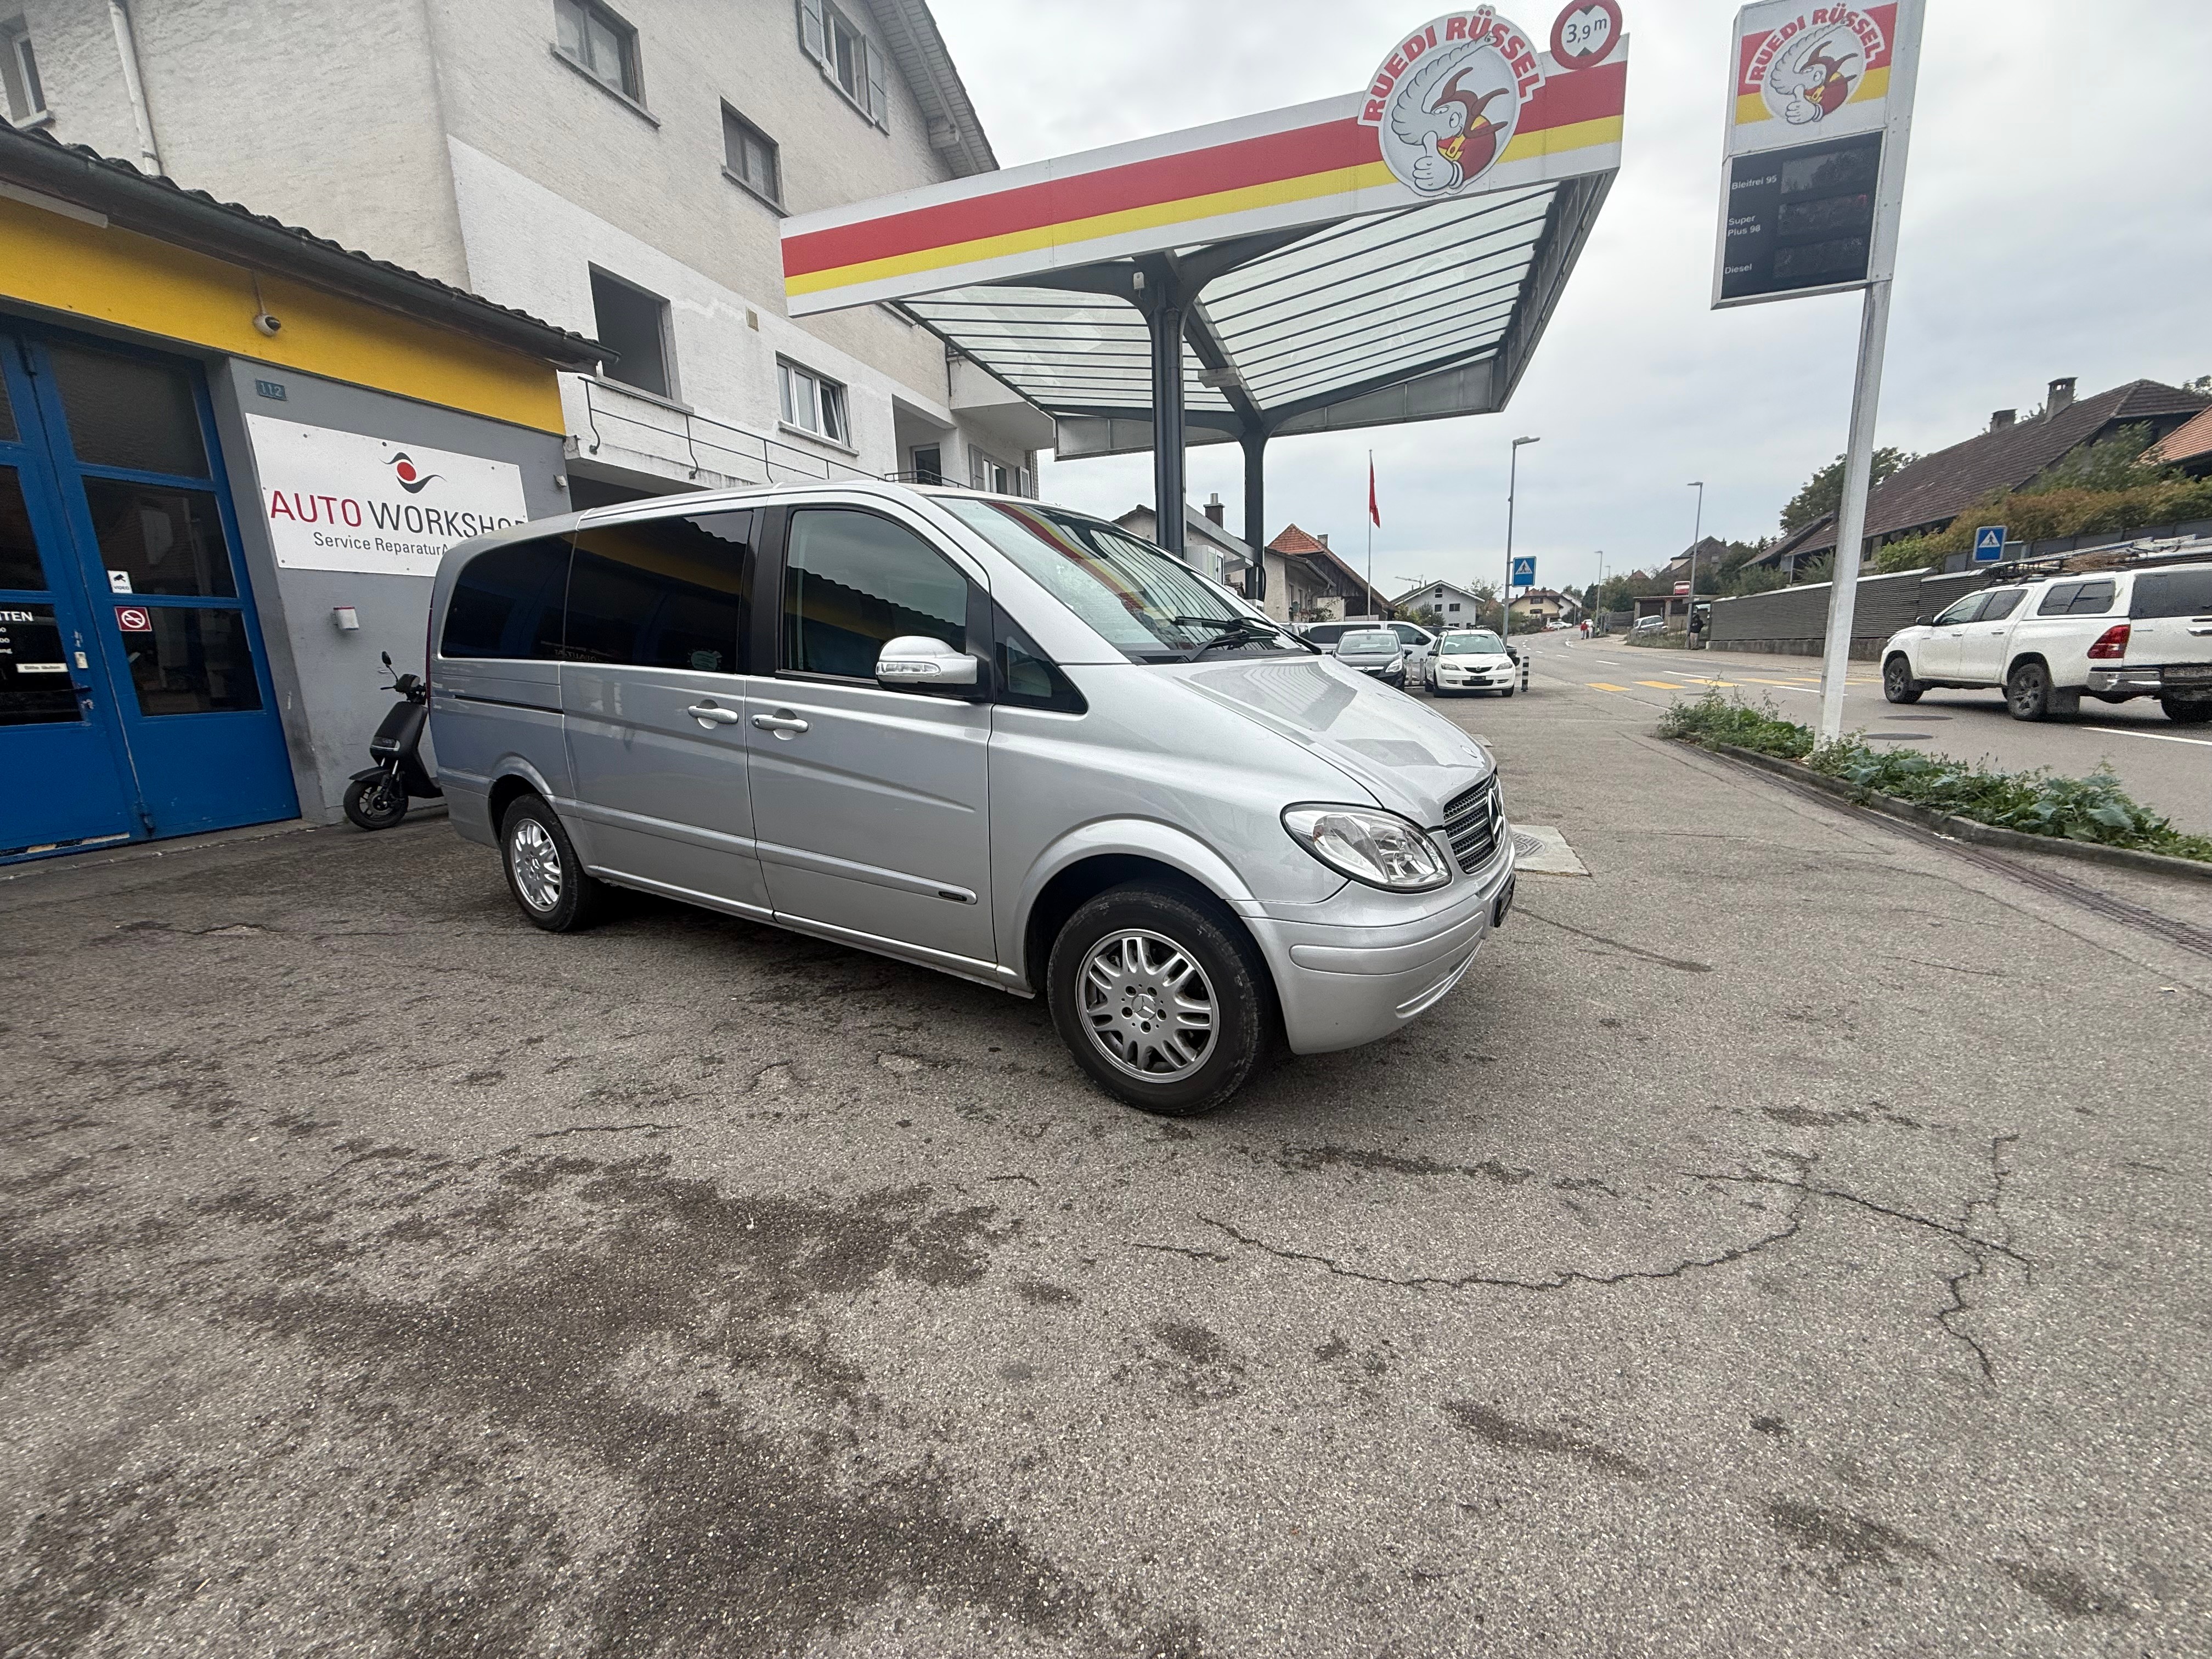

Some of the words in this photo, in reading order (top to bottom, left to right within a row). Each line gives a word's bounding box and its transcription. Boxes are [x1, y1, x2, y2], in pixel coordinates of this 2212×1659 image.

[1749, 15, 1805, 81] RUEDI
[1812, 3, 1881, 60] RÜSSEL
[1363, 25, 1437, 121] RUEDI
[1446, 9, 1540, 99] RÜSSEL
[1732, 177, 1764, 190] Bleifrei
[1766, 174, 1777, 184] 95
[1728, 216, 1756, 225] Super
[1728, 228, 1747, 236] Plus
[1750, 224, 1760, 233] 98
[1725, 263, 1752, 274] Diesel
[261, 383, 283, 397] 112
[271, 490, 362, 527] AUTO
[367, 500, 524, 538] WORKSH
[313, 532, 371, 549] Service
